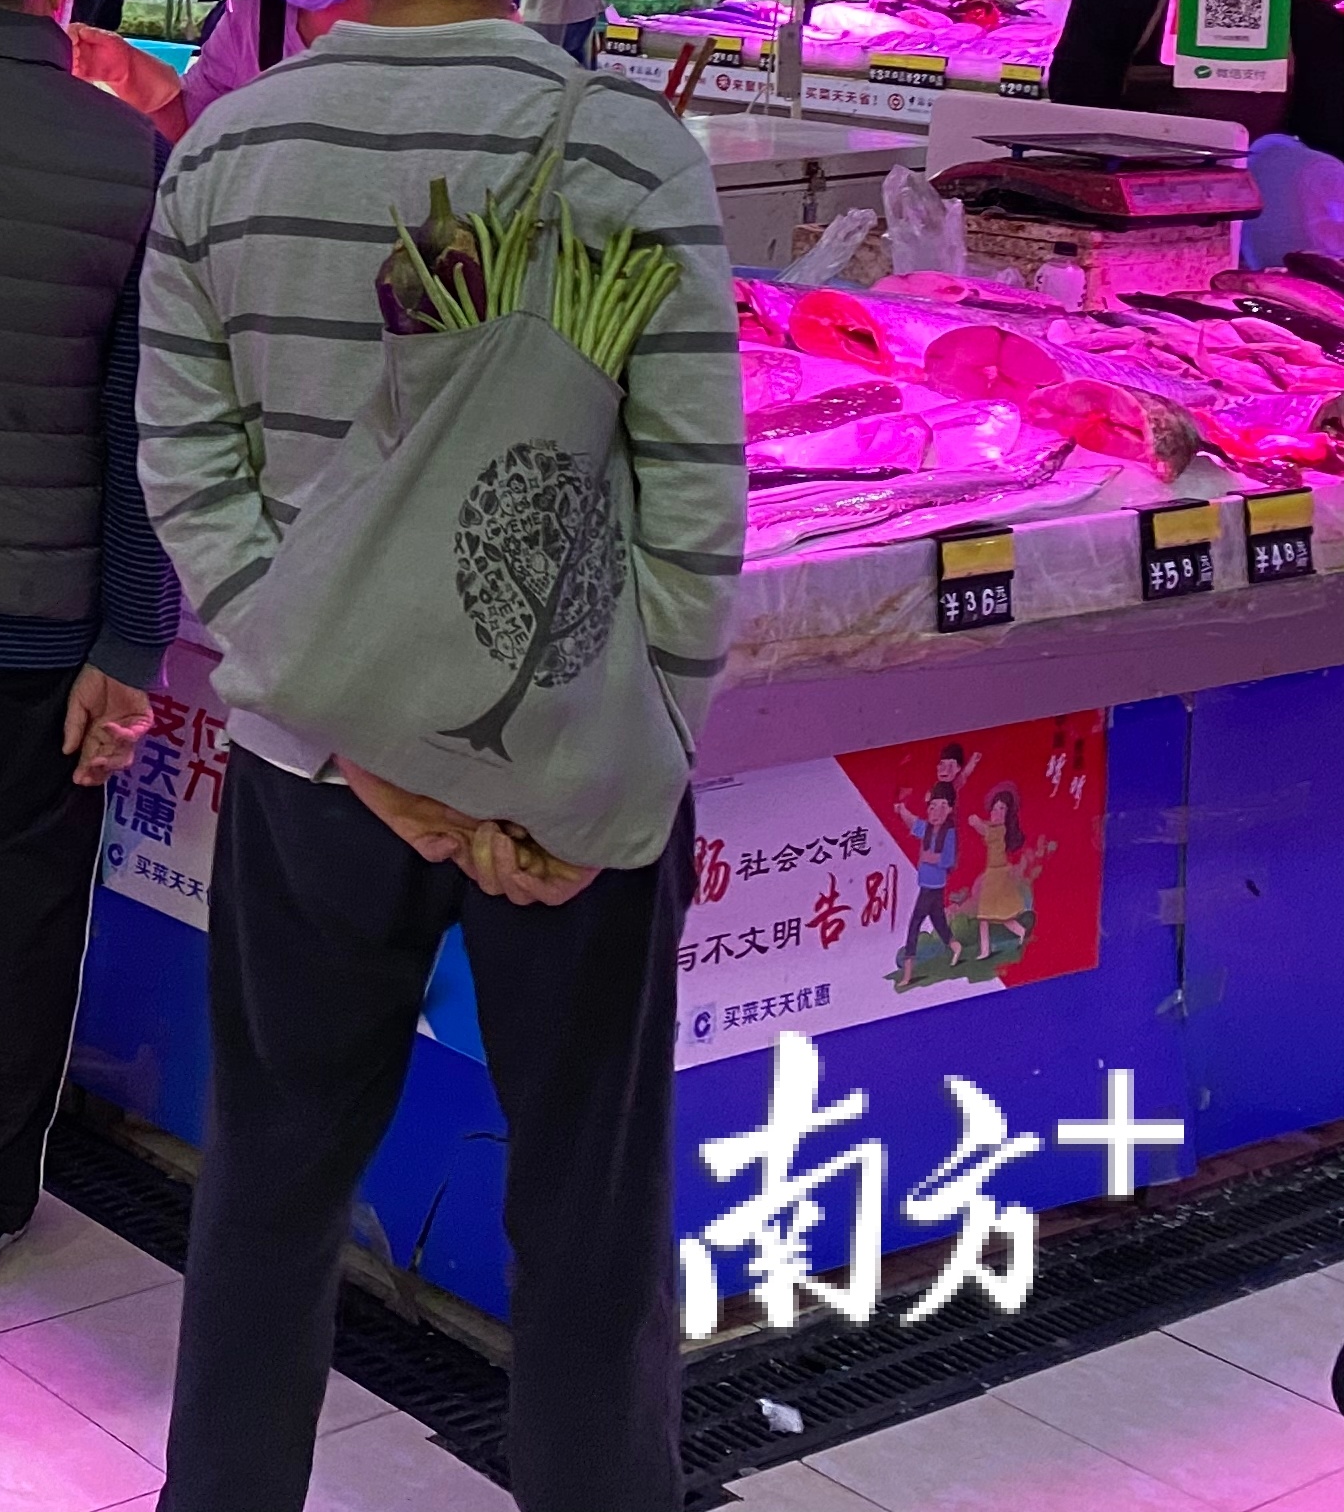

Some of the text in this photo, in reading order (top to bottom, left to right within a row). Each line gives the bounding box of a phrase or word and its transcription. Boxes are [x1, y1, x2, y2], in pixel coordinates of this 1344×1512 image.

[1216, 68, 1265, 81] 微信支付
[1255, 542, 1295, 573] ¥48
[1150, 559, 1194, 591] ¥58
[945, 587, 995, 622] ¥36
[135, 854, 205, 903] 买菜天天
[723, 984, 832, 1030] 买菜天天优惠
